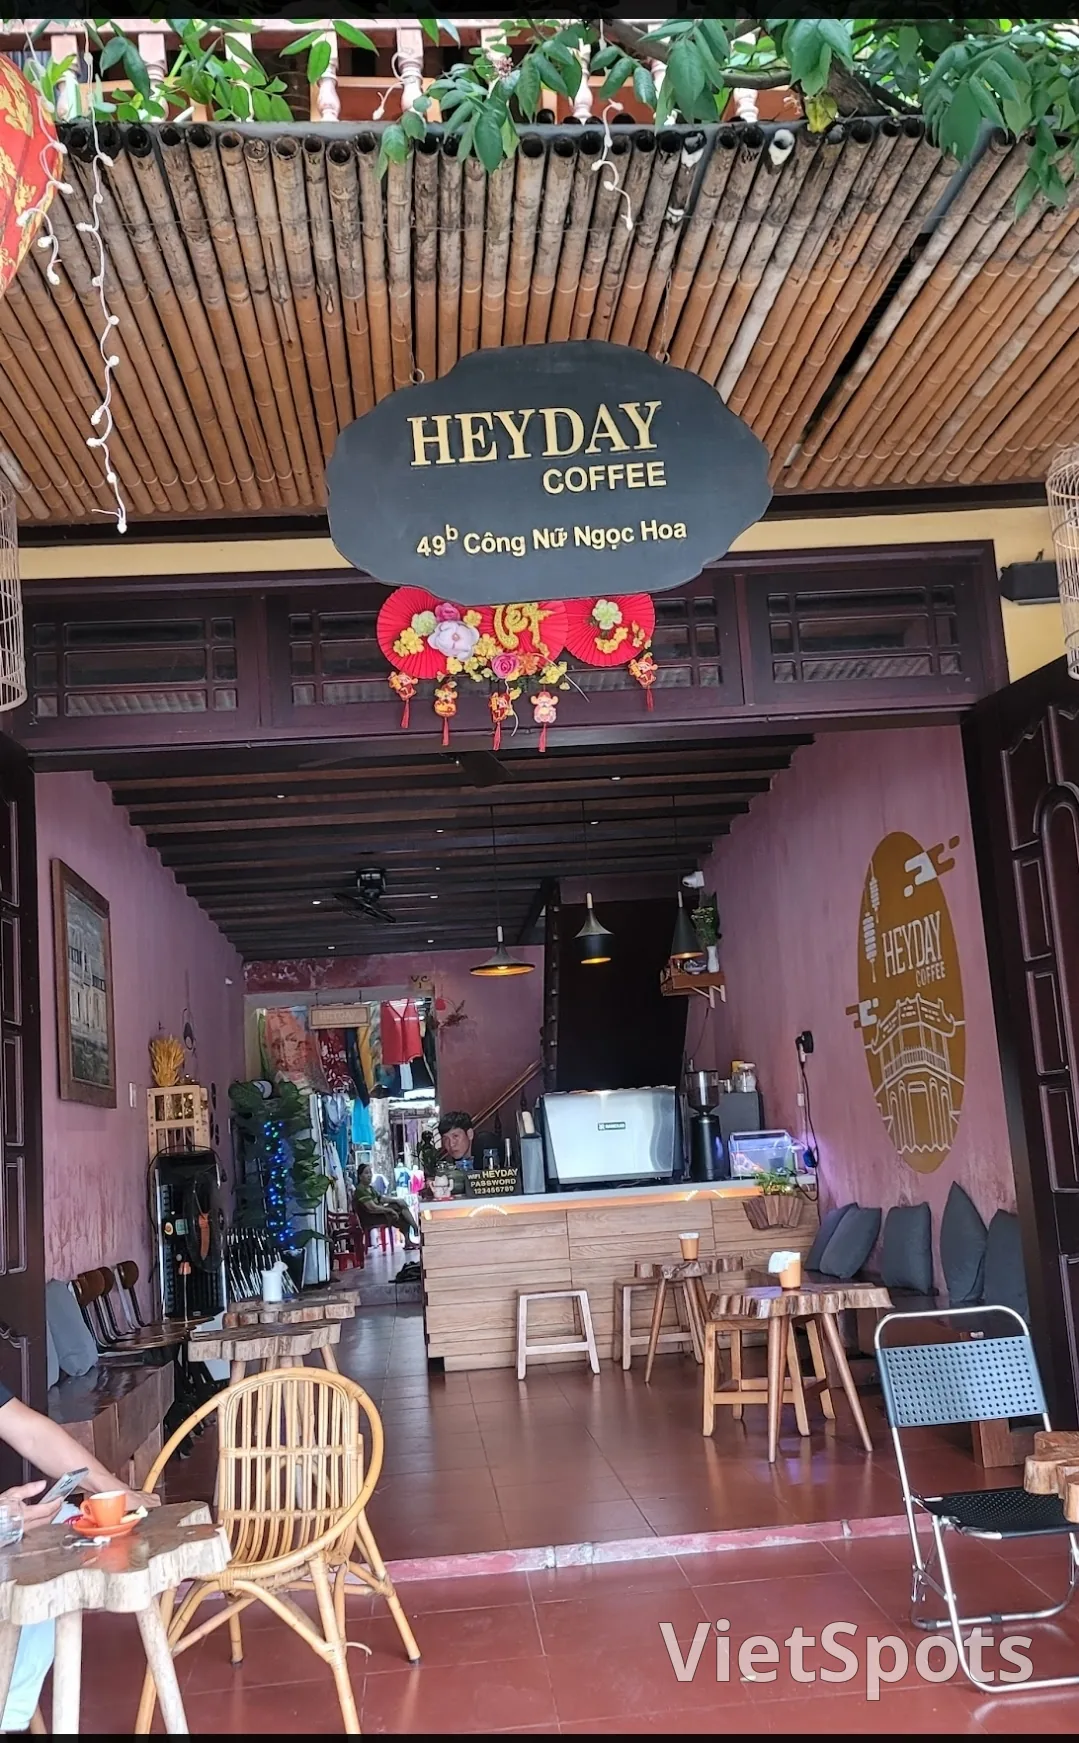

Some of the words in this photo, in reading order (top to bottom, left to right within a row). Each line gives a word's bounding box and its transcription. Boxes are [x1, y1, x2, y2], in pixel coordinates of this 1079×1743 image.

[407, 400, 662, 467] HEYDAY
[542, 461, 667, 495] COFFEE
[463, 531, 525, 557] Công
[532, 527, 567, 550] Nữ
[573, 525, 635, 550] Ngọc
[640, 519, 687, 542] Hoa
[882, 910, 942, 978] HEYDAY
[915, 961, 946, 988] COFFEE
[470, 1178, 517, 1188] PASSWORD
[482, 1168, 518, 1179] HEYDAY
[474, 1185, 514, 1195] 123456789
